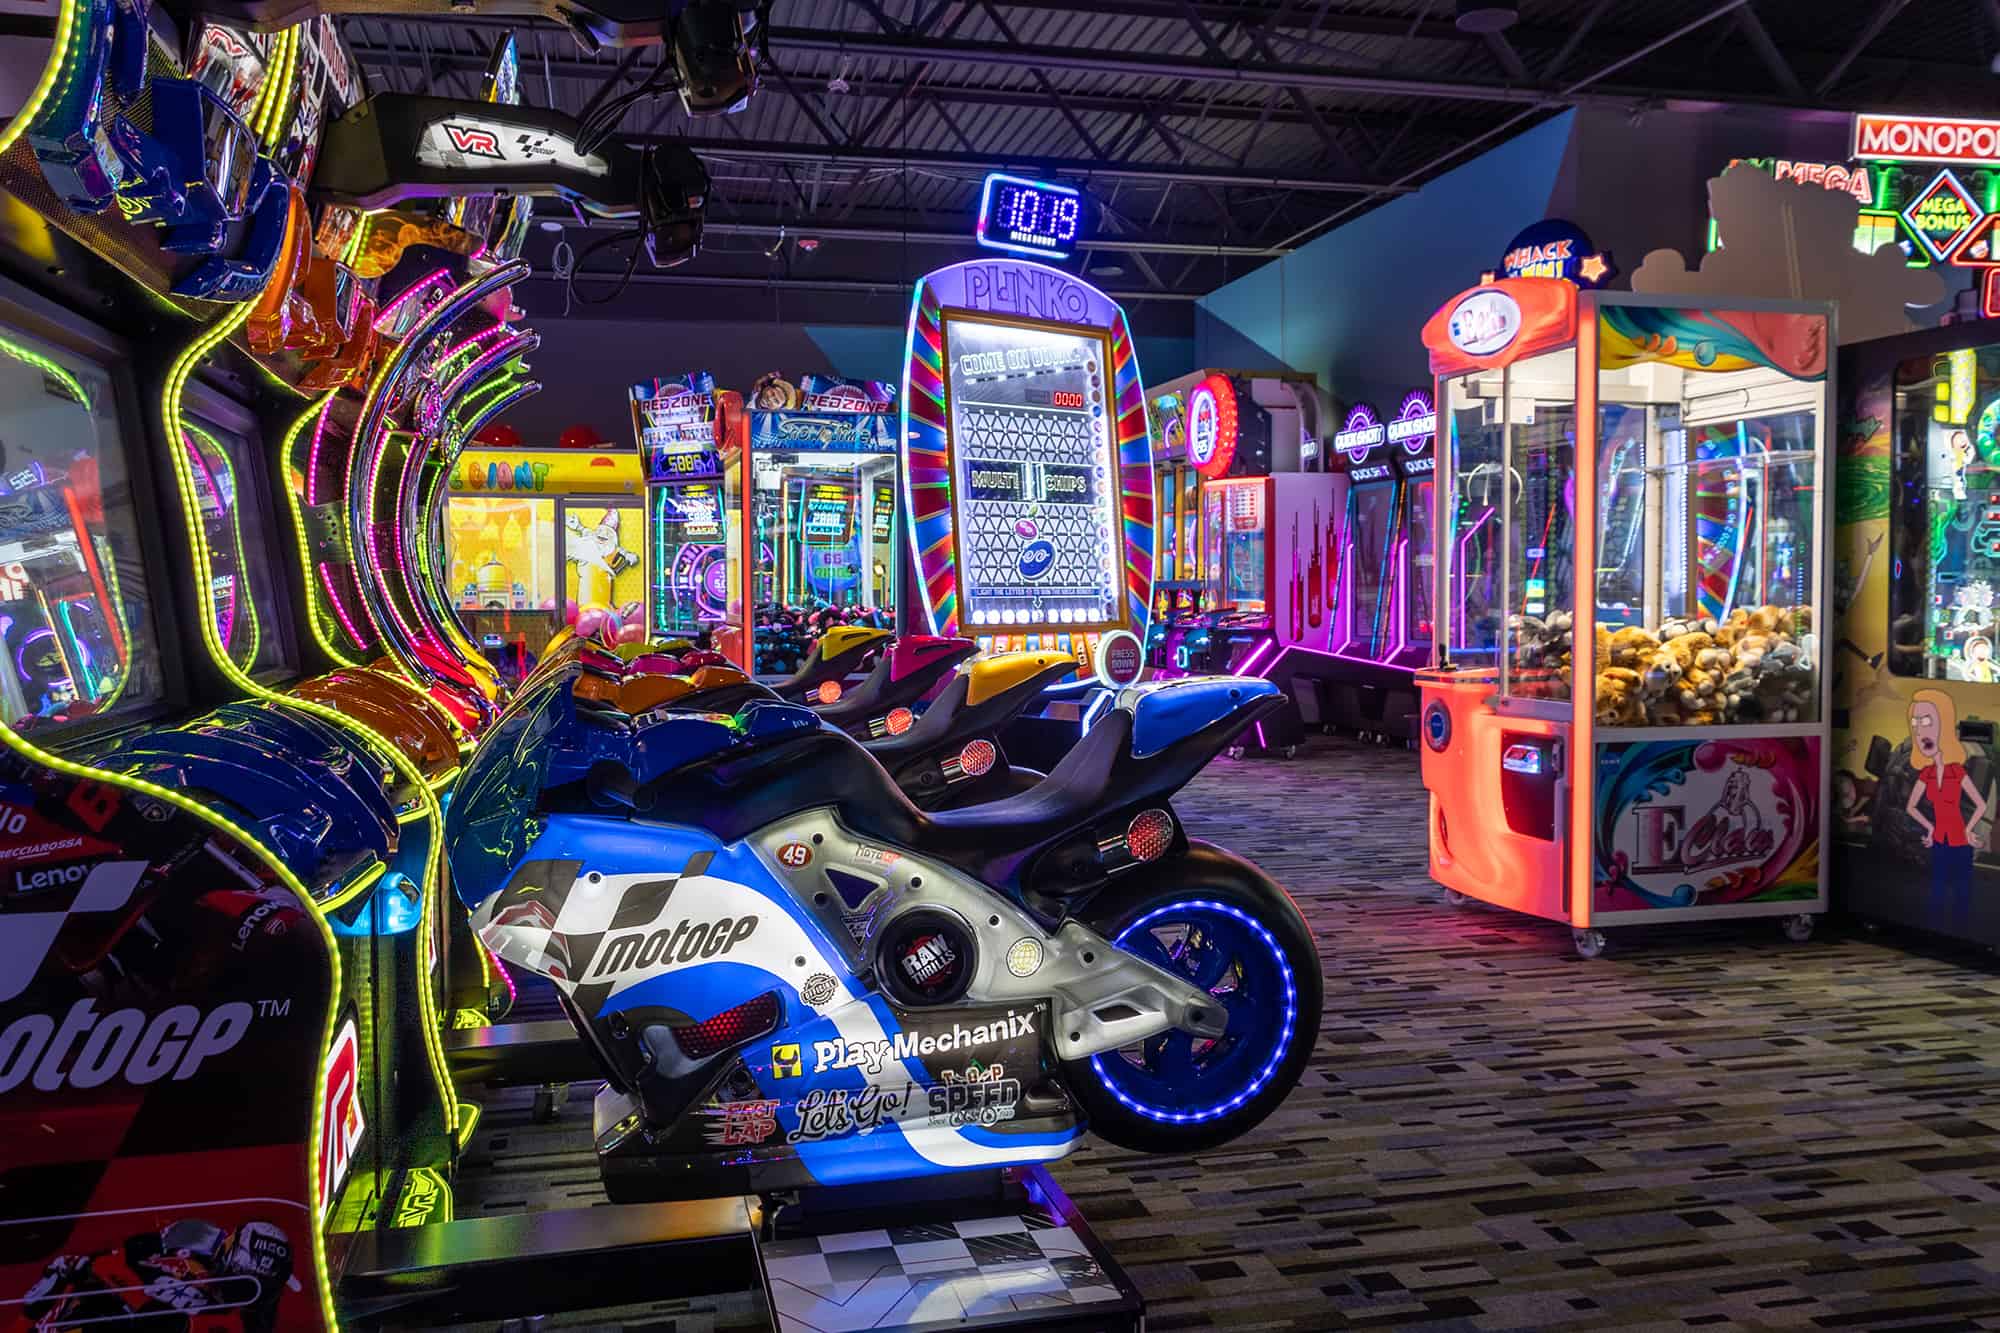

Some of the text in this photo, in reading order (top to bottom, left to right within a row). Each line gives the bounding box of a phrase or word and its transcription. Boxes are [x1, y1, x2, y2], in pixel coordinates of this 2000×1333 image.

[453, 131, 494, 152] VR
[1775, 161, 1873, 204] MEGA
[1919, 198, 1967, 213] MEGA
[1915, 213, 1971, 231] BONUS
[1504, 239, 1573, 272] WHACK
[964, 266, 1092, 326] PLINKO
[960, 351, 1006, 375] COME
[642, 395, 710, 412] RED ZONE
[809, 395, 888, 413] RED ZONE
[1054, 391, 1083, 407] 0000
[468, 460, 549, 492] GIANT
[1044, 474, 1087, 493] CHIPS
[783, 844, 807, 865] 49
[902, 933, 951, 973] RAW
[911, 950, 956, 985] THRILLS
[257, 999, 291, 1017] TM
[814, 1037, 889, 1075] Play
[894, 1010, 1036, 1061] Mechanix
[928, 1079, 1021, 1117] SPEED
[787, 1081, 913, 1142] Let's Go!
[723, 1119, 777, 1145] LAP
